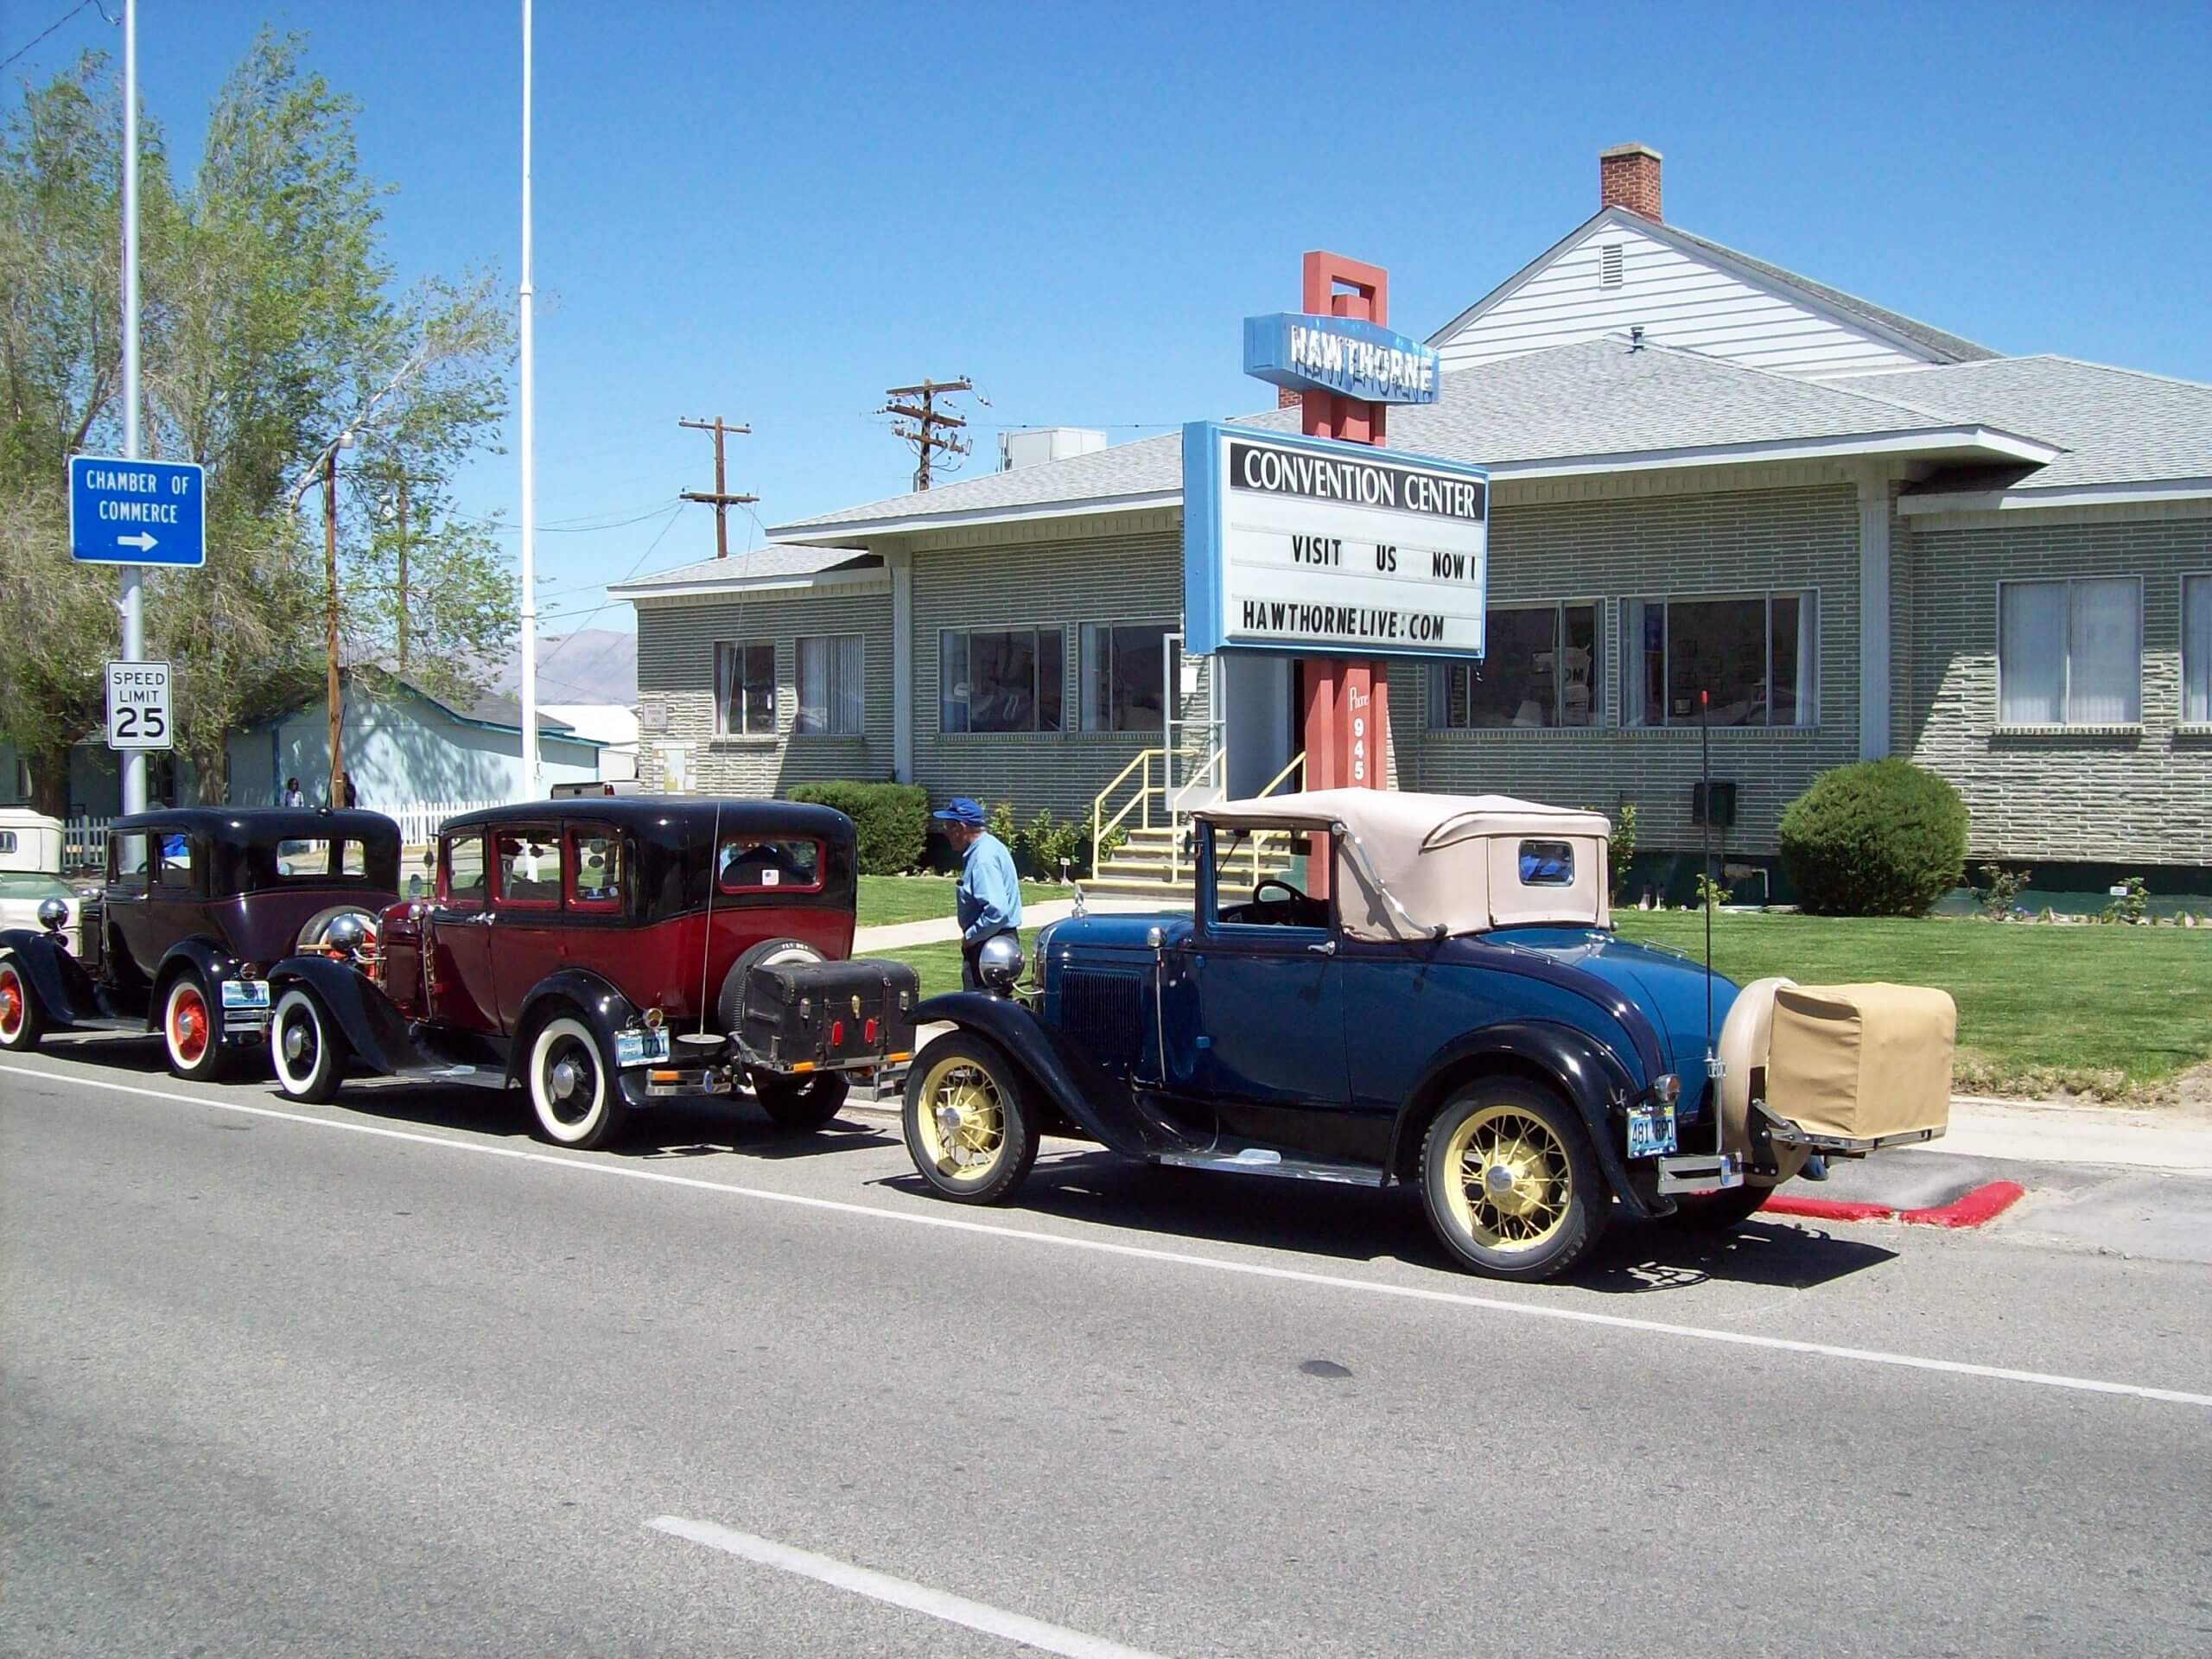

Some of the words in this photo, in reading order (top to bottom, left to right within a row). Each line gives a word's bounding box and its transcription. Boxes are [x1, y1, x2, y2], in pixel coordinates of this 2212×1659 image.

[1291, 325, 1433, 394] HAWTHORNE
[86, 469, 157, 493] CHAMBER
[171, 475, 190, 495] OF
[1244, 449, 1395, 506] CONVENTION
[1404, 474, 1476, 518] CENTER
[99, 499, 179, 524] COMMERCE
[1292, 534, 1342, 567] VISIT
[1376, 543, 1397, 573] US
[1432, 551, 1465, 581] NOW
[113, 671, 165, 685] SPEED
[119, 690, 160, 703] LIMIT
[116, 707, 165, 738] 25
